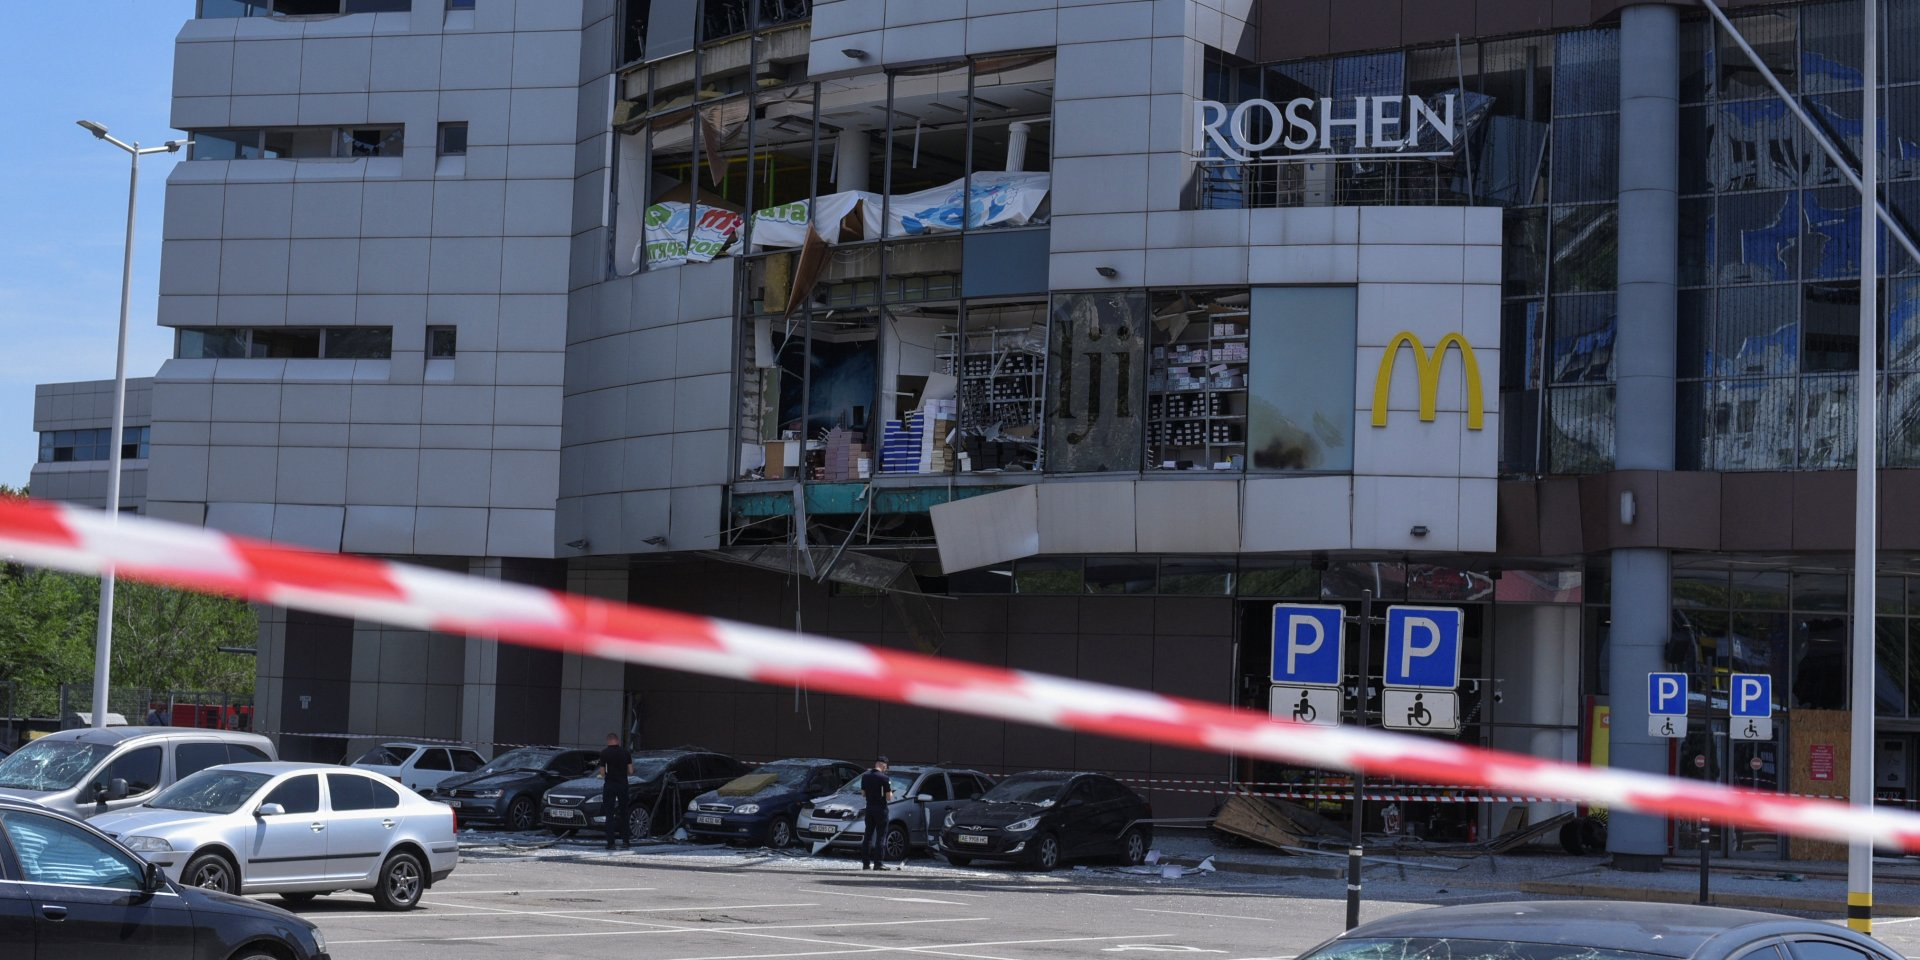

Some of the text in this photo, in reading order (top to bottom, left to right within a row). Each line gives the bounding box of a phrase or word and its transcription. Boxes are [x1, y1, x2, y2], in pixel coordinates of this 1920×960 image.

[1193, 94, 1455, 161] ROSHEN
[1287, 614, 1325, 675] P
[1401, 616, 1441, 678] P
[1658, 677, 1679, 711] P
[1741, 678, 1762, 712] P
